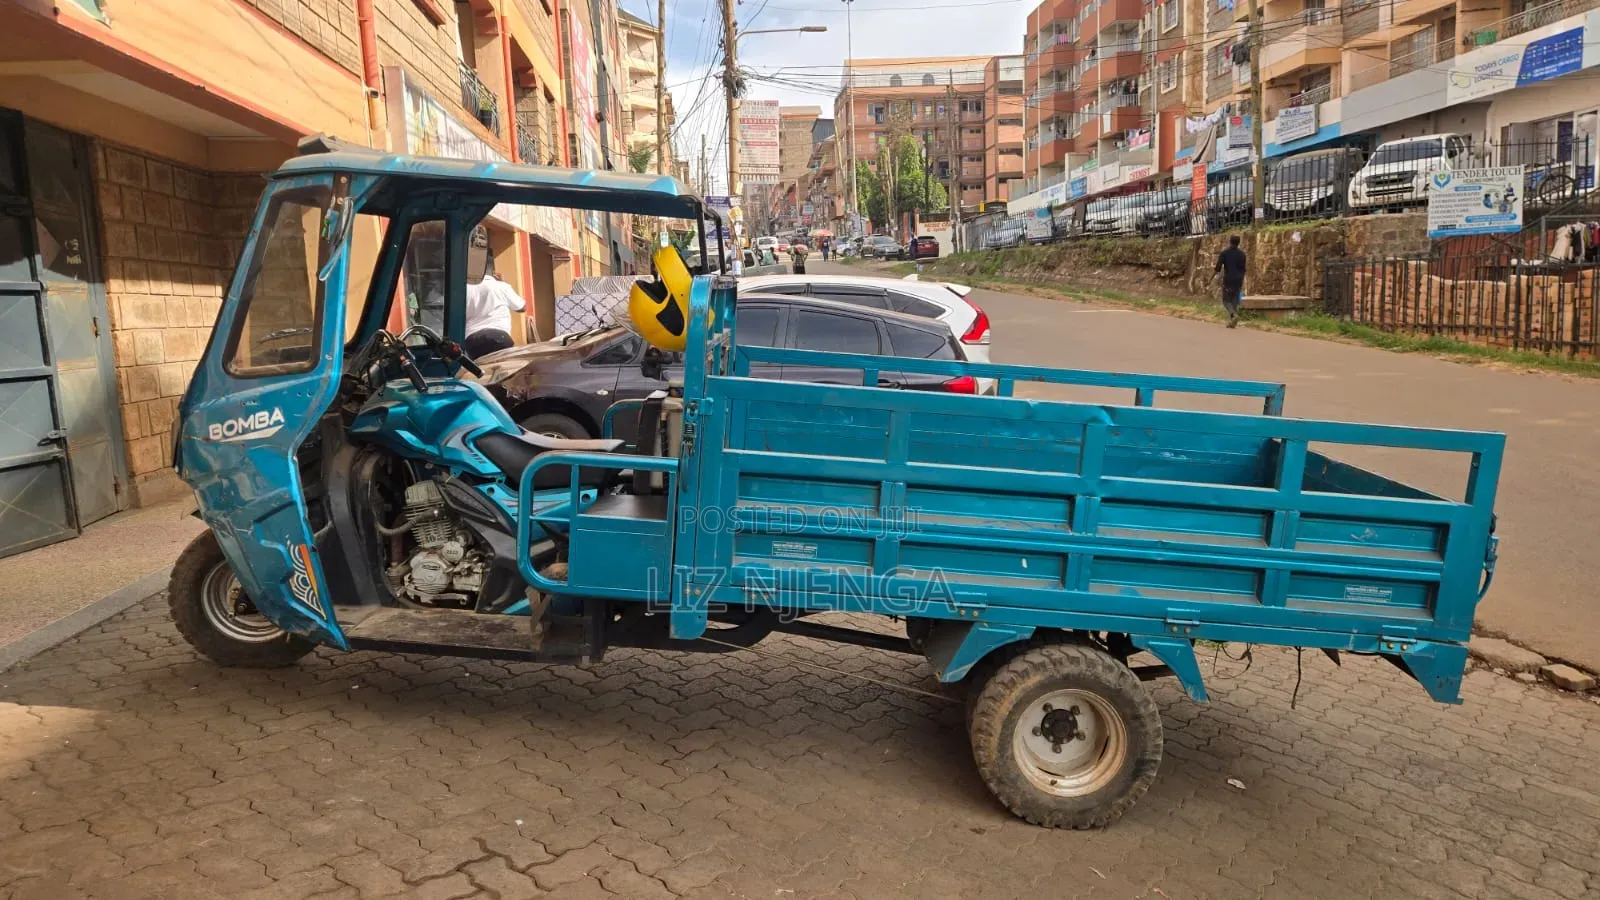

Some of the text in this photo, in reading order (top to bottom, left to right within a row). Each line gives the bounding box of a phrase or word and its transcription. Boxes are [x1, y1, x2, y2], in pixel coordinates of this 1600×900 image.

[1498, 53, 1520, 66] CARGO
[1128, 168, 1151, 180] CHEMIST
[1453, 167, 1521, 179] TENDER TOUCH
[208, 407, 285, 441] BOMBA
